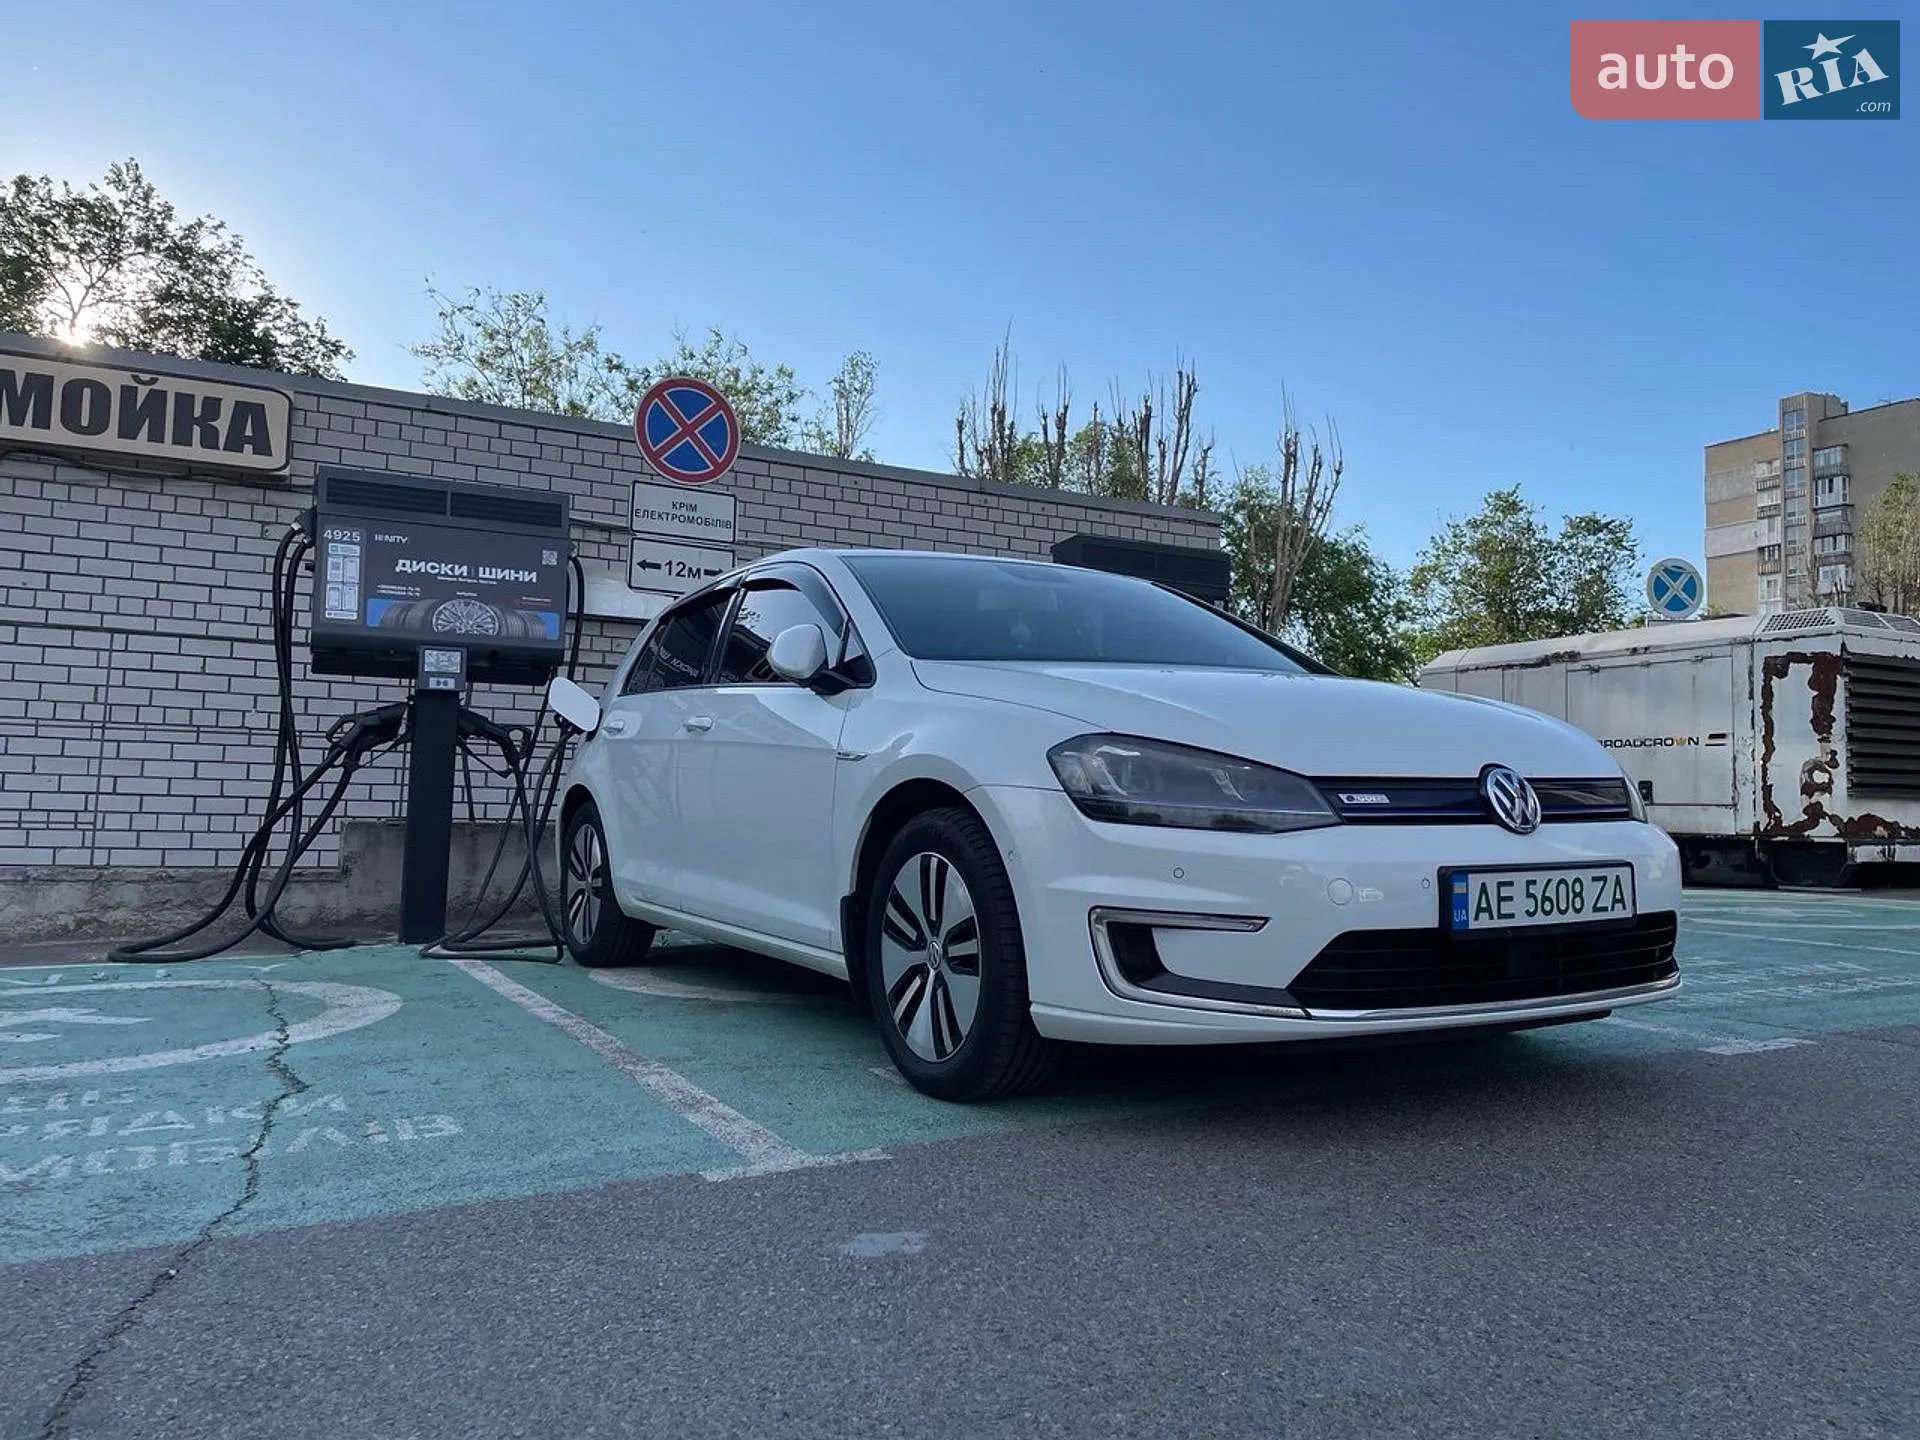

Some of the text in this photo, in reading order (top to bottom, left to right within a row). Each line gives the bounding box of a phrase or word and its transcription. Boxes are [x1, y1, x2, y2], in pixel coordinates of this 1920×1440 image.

[0, 368, 273, 457] МОЙКА
[671, 500, 698, 513] КРІМ
[634, 508, 732, 529] ЕЛЕКТРОМОБІЛІВ
[324, 529, 360, 542] 4925
[395, 559, 468, 577] ДИСКИ
[478, 566, 537, 583] ШИНИ
[1474, 874, 1627, 921] AE 5608 ZA
[1453, 909, 1467, 922] UA
